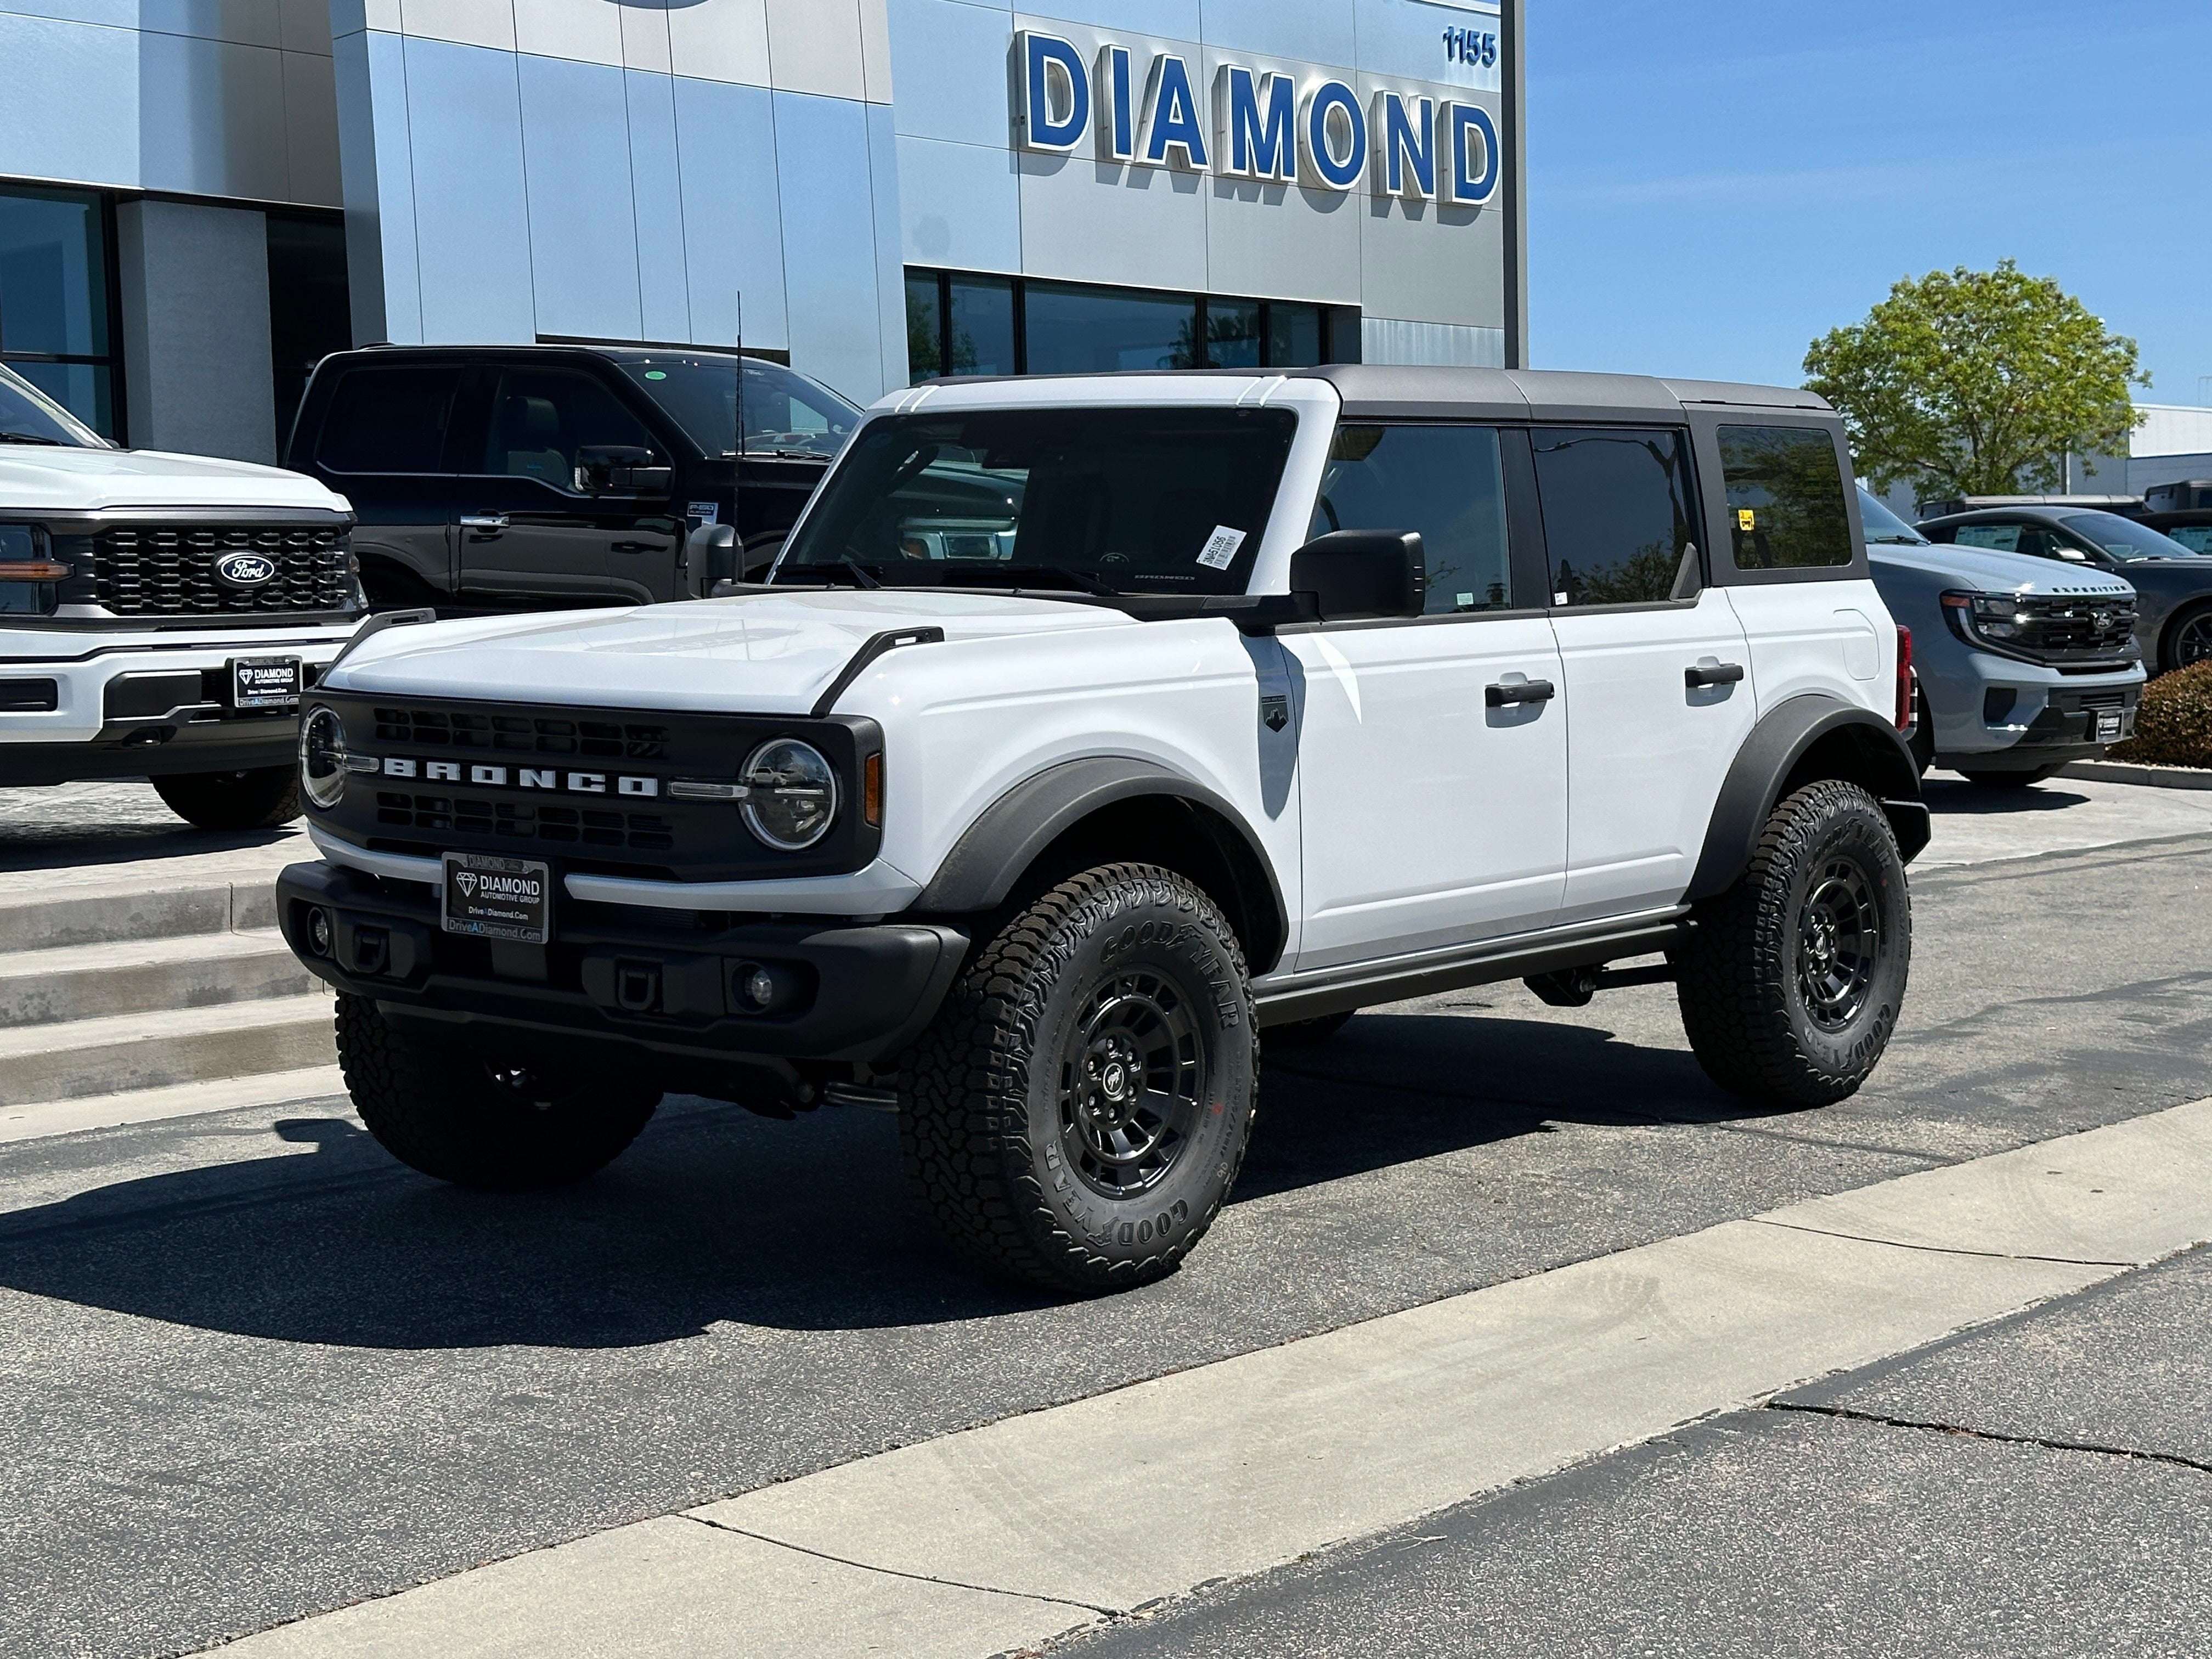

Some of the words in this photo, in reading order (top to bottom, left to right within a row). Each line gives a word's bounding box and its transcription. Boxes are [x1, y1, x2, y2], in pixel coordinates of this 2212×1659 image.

[1443, 26, 1497, 68] 1155
[1020, 30, 1501, 206] DIAMOND
[232, 560, 265, 578] Ford
[255, 668, 294, 679] DIAMOND
[384, 758, 658, 797] BRONCO
[469, 854, 505, 870] DIAMOND
[480, 875, 540, 896] DIAMOND
[481, 891, 518, 902] AUTOMOTIVE
[519, 895, 540, 904] GROUP
[449, 919, 541, 940] DriveADiamond.Com
[1100, 921, 1240, 1030] GOODYEAR
[1045, 1140, 1189, 1247] GOODYEAR
